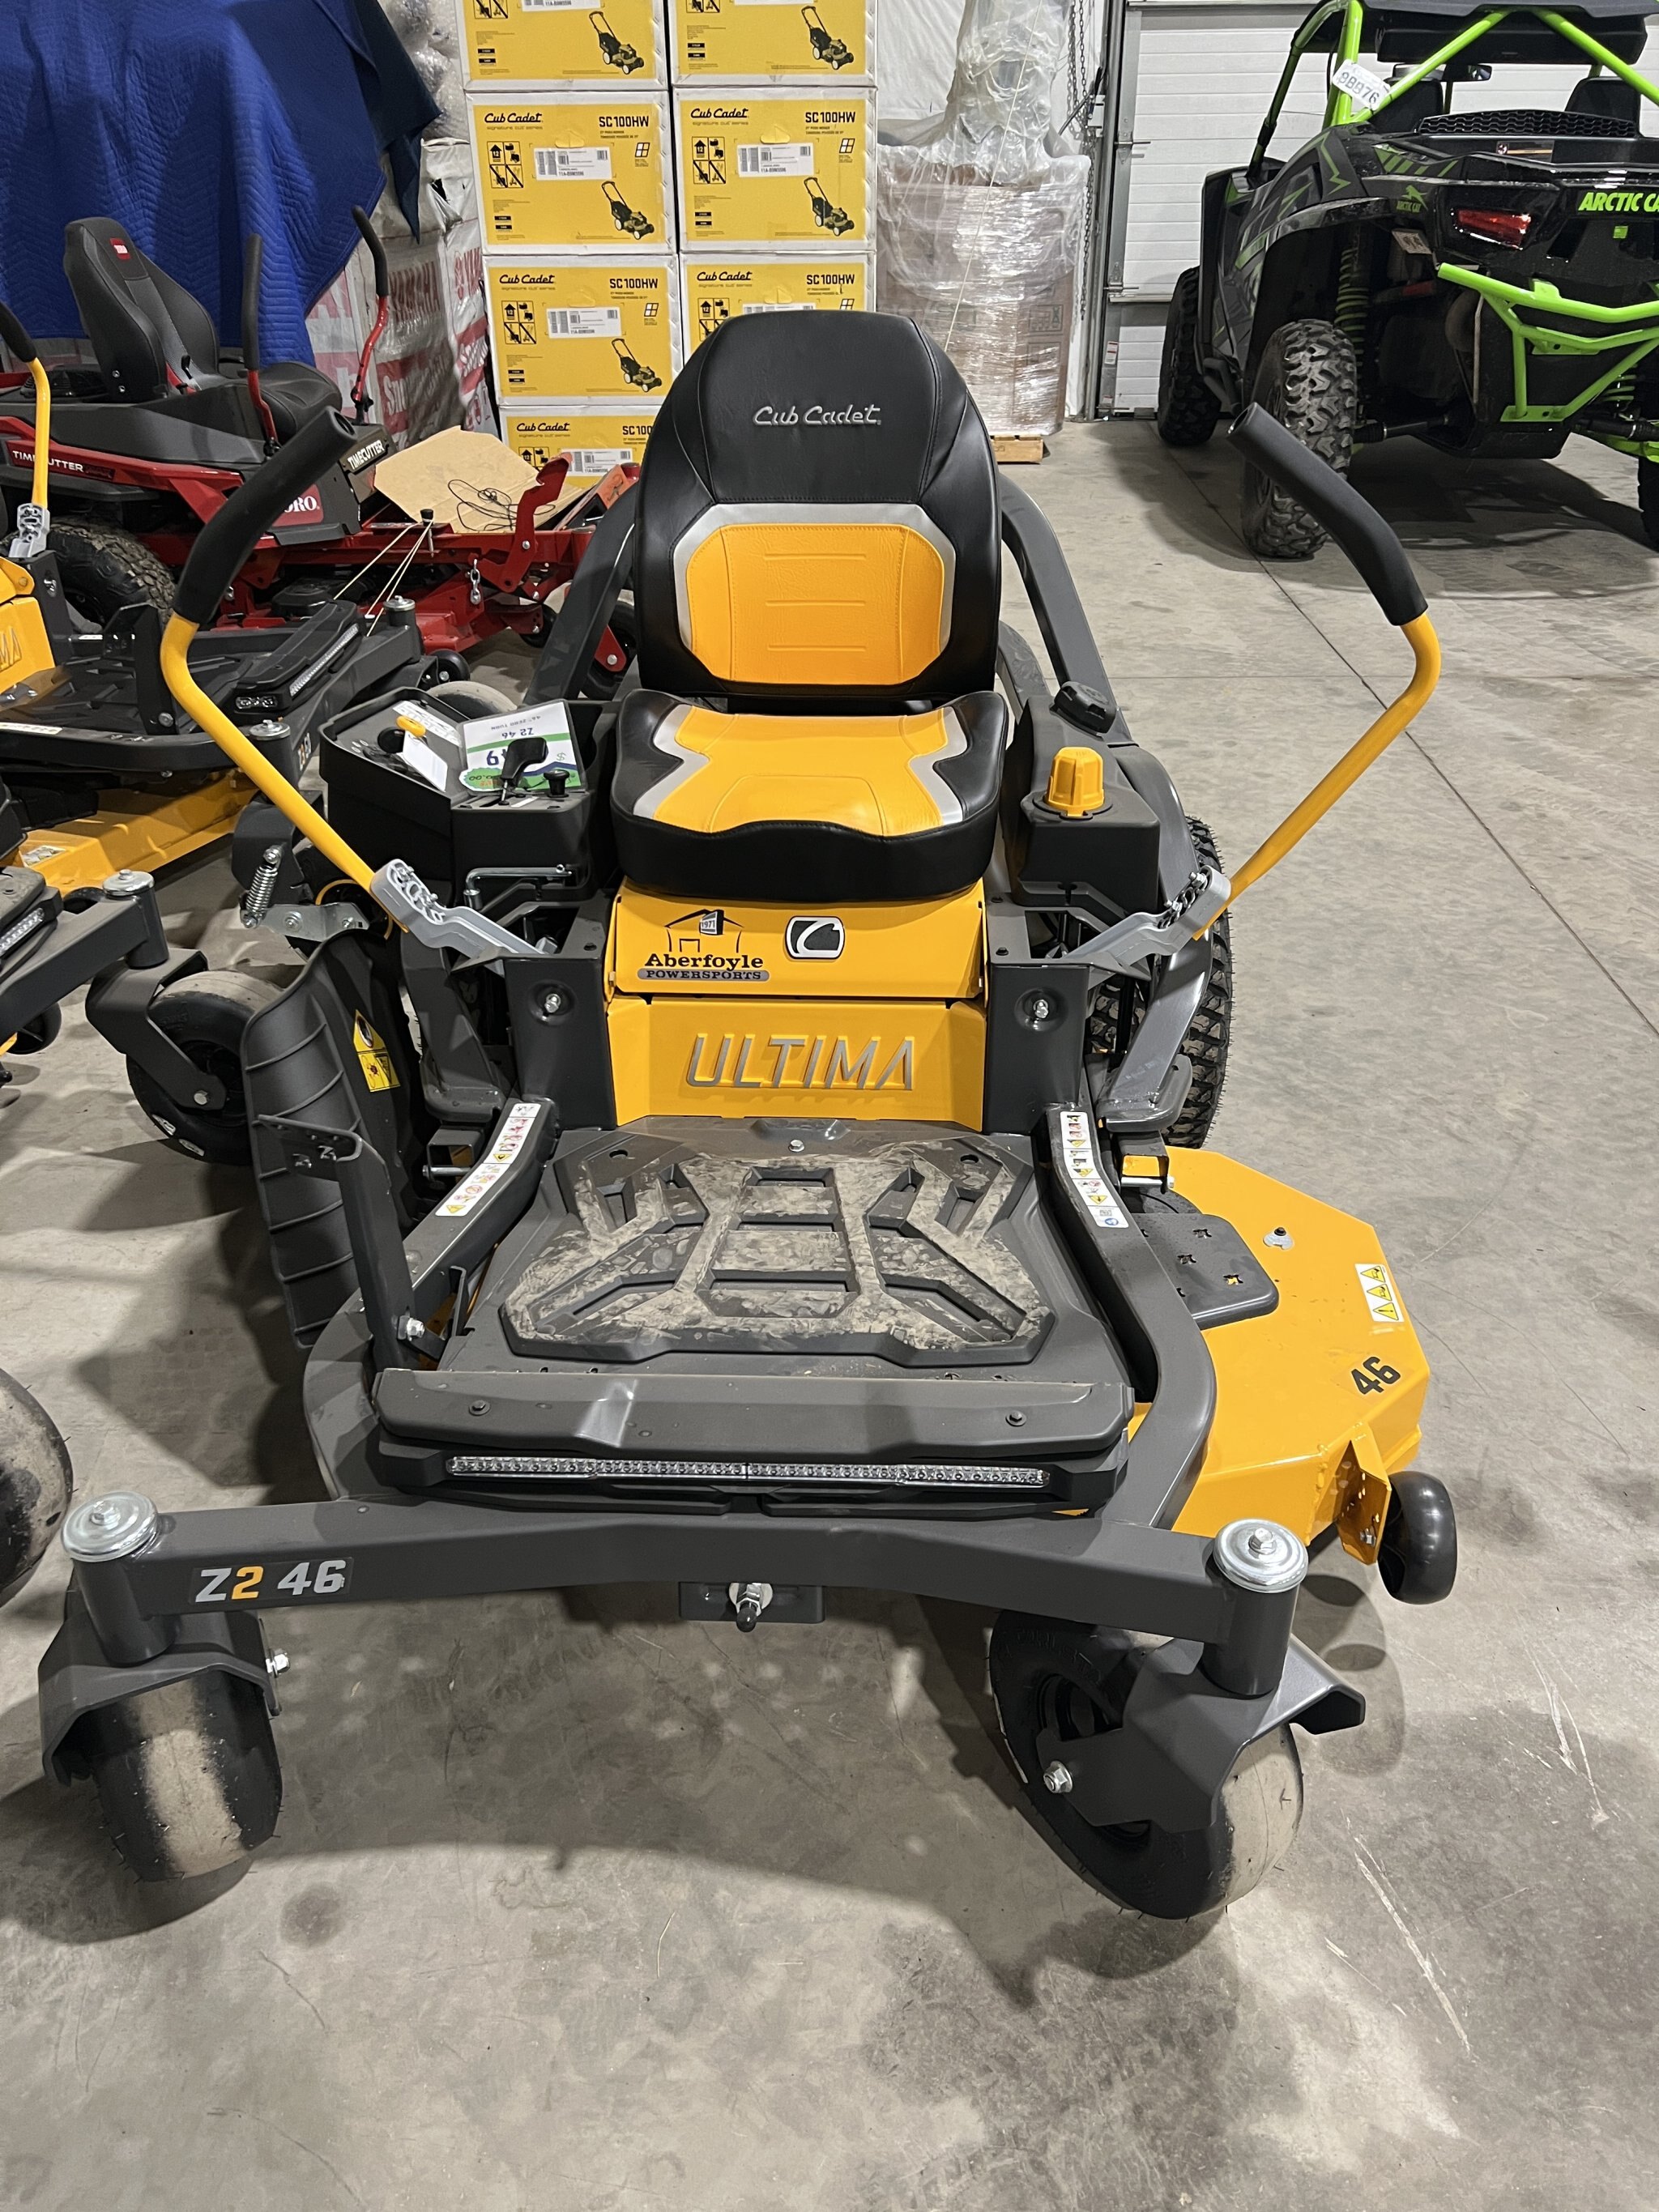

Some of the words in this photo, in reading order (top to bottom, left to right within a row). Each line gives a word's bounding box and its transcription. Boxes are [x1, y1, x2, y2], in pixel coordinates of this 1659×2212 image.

[484, 113, 505, 123] Cub
[507, 113, 543, 123] Cadet
[690, 108, 711, 118] Cub
[713, 108, 748, 118] Cadet
[1578, 192, 1644, 211] ARCTIC
[499, 275, 520, 284] Cub
[521, 274, 556, 284] Cadet
[697, 271, 717, 281] Cub
[719, 271, 753, 281] Cadet
[753, 405, 799, 426] Cub
[803, 404, 881, 426] Cadet
[517, 422, 535, 432] Cub
[537, 422, 570, 432] Cadet
[12, 450, 84, 472] TIMUTTER
[347, 439, 385, 470] TIMECUTTER
[284, 496, 318, 514] RO
[701, 919, 715, 929] 1971
[644, 953, 764, 972] Aberfoyle
[646, 970, 761, 980] POWERSPORTS
[685, 1034, 915, 1091] ULTIMA
[1350, 1356, 1401, 1395] 46
[195, 1565, 264, 1603] Z2
[277, 1559, 346, 1596] 46
